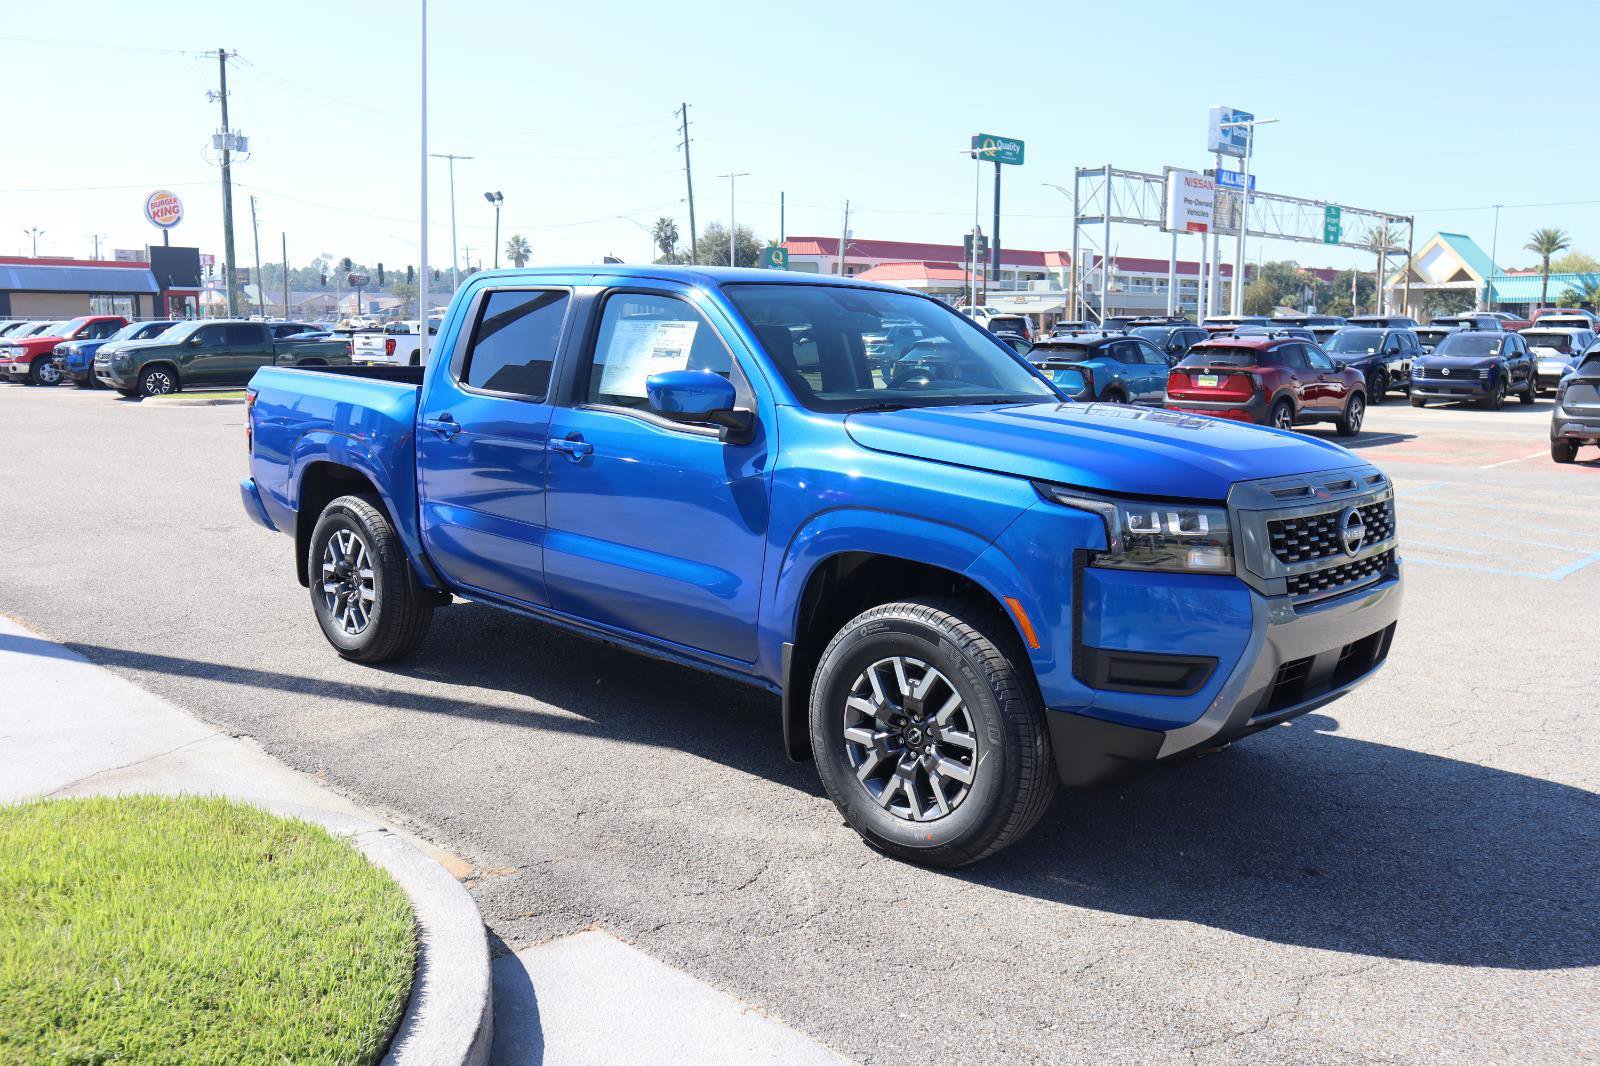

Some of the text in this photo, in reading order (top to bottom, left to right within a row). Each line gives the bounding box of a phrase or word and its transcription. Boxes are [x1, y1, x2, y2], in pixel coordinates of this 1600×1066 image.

[997, 140, 1020, 154] Quality
[1184, 176, 1214, 190] NISSAN
[1221, 171, 1234, 184] ALL
[150, 198, 178, 209] BURGER
[1184, 197, 1213, 207] Pre-Owned
[152, 205, 180, 219] KING
[1187, 208, 1209, 217] Vehicles
